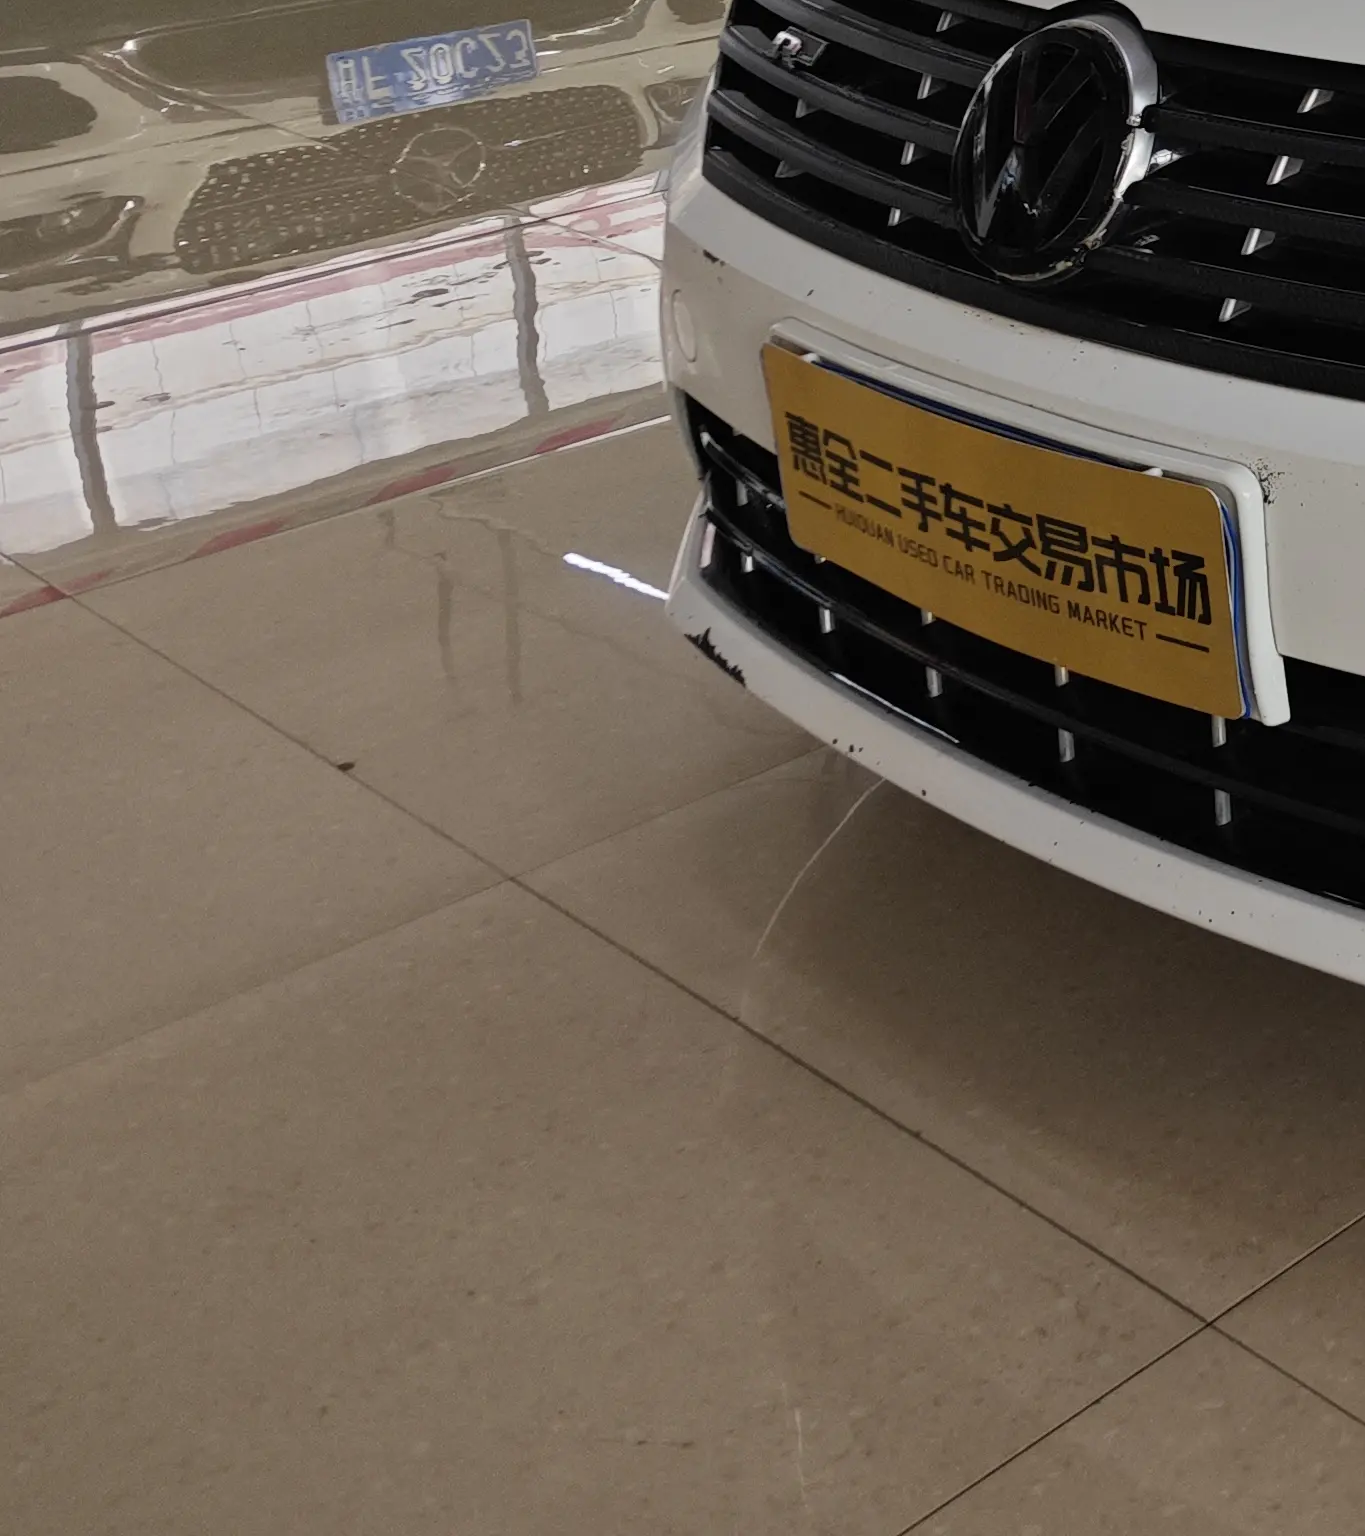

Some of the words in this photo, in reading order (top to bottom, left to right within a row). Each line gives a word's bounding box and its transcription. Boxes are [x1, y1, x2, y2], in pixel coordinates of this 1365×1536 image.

[785, 411, 1212, 626] 惠全二手车交易市场
[834, 502, 895, 548] HUIQUAN
[898, 534, 939, 568] USED
[942, 554, 976, 585] CAR
[981, 569, 1061, 615] TRADING
[1067, 599, 1148, 642] MARKET
